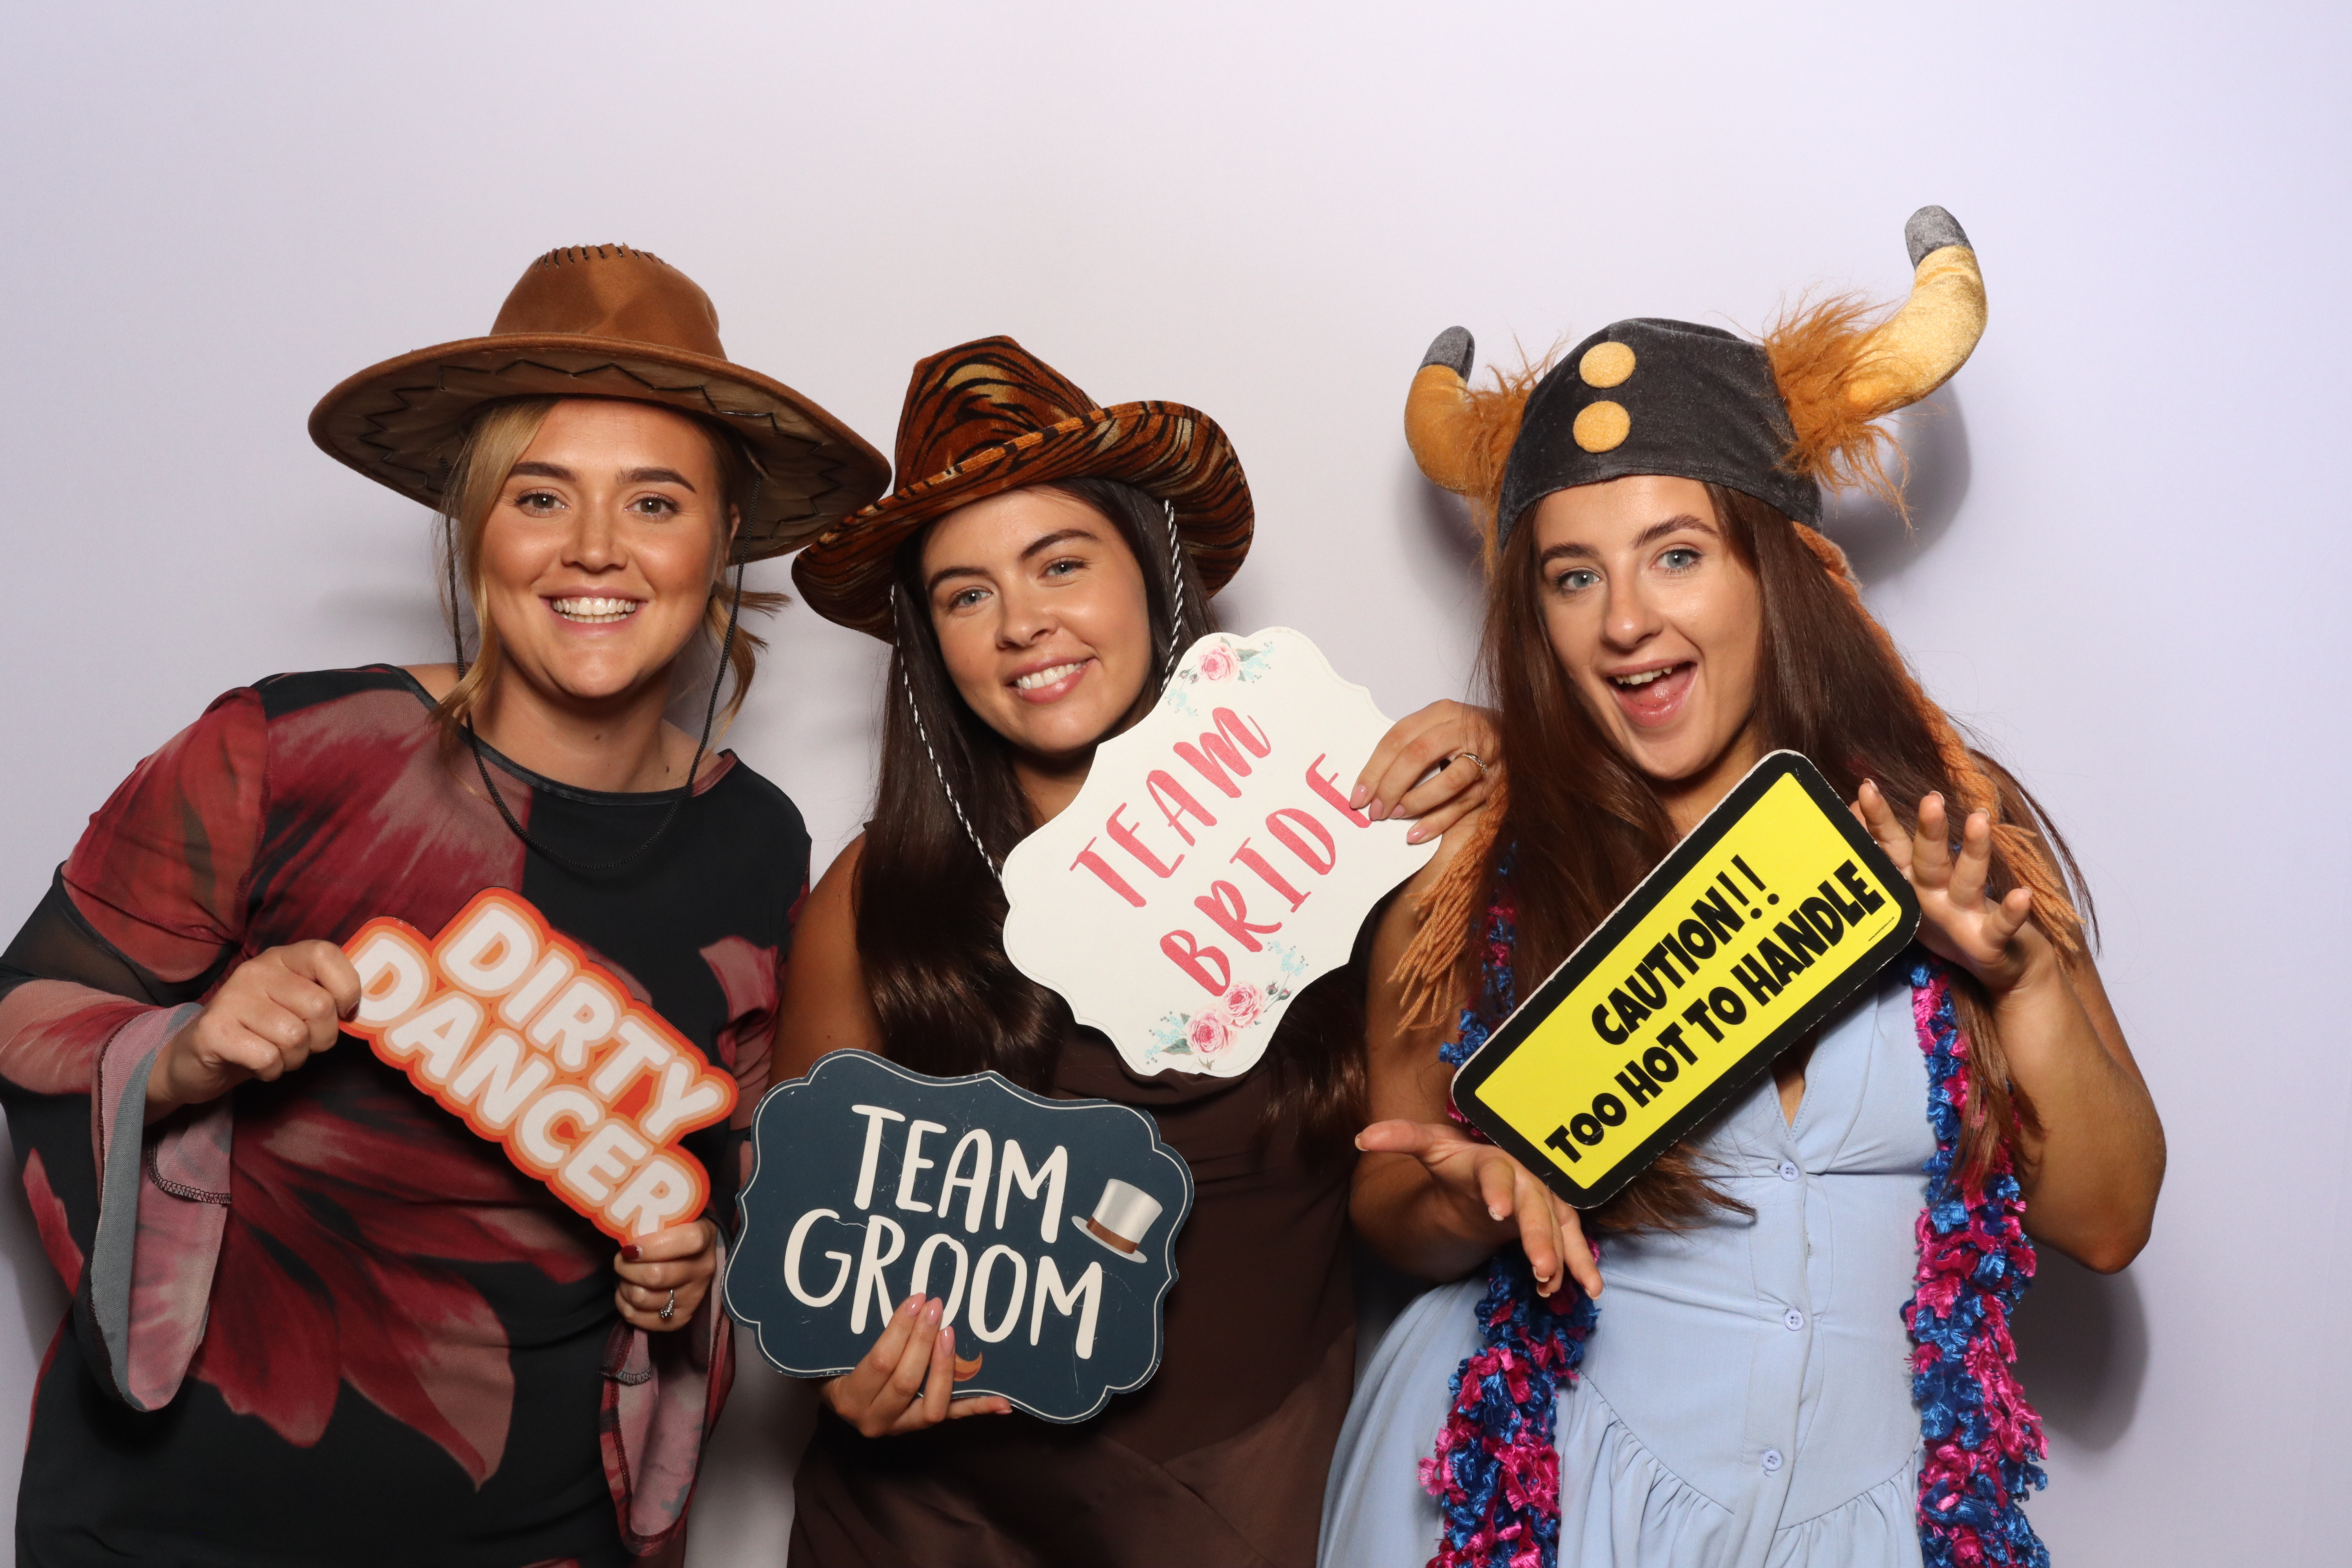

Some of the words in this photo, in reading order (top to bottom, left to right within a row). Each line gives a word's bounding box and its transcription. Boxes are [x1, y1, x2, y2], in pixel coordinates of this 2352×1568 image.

[1069, 706, 1272, 908] TEAM
[1159, 753, 1373, 996] BRIDE
[445, 908, 719, 1139] DIRTY
[1543, 1092, 1628, 1163] TOO
[1613, 1022, 1698, 1109] HOT
[1681, 986, 1748, 1044] TO
[1730, 859, 1886, 1007] HANDLE
[1591, 854, 1780, 1046] CAUTION!!
[351, 938, 690, 1236] DANCER
[851, 1104, 1068, 1244] TEAM
[784, 1209, 1103, 1359] GROOM
